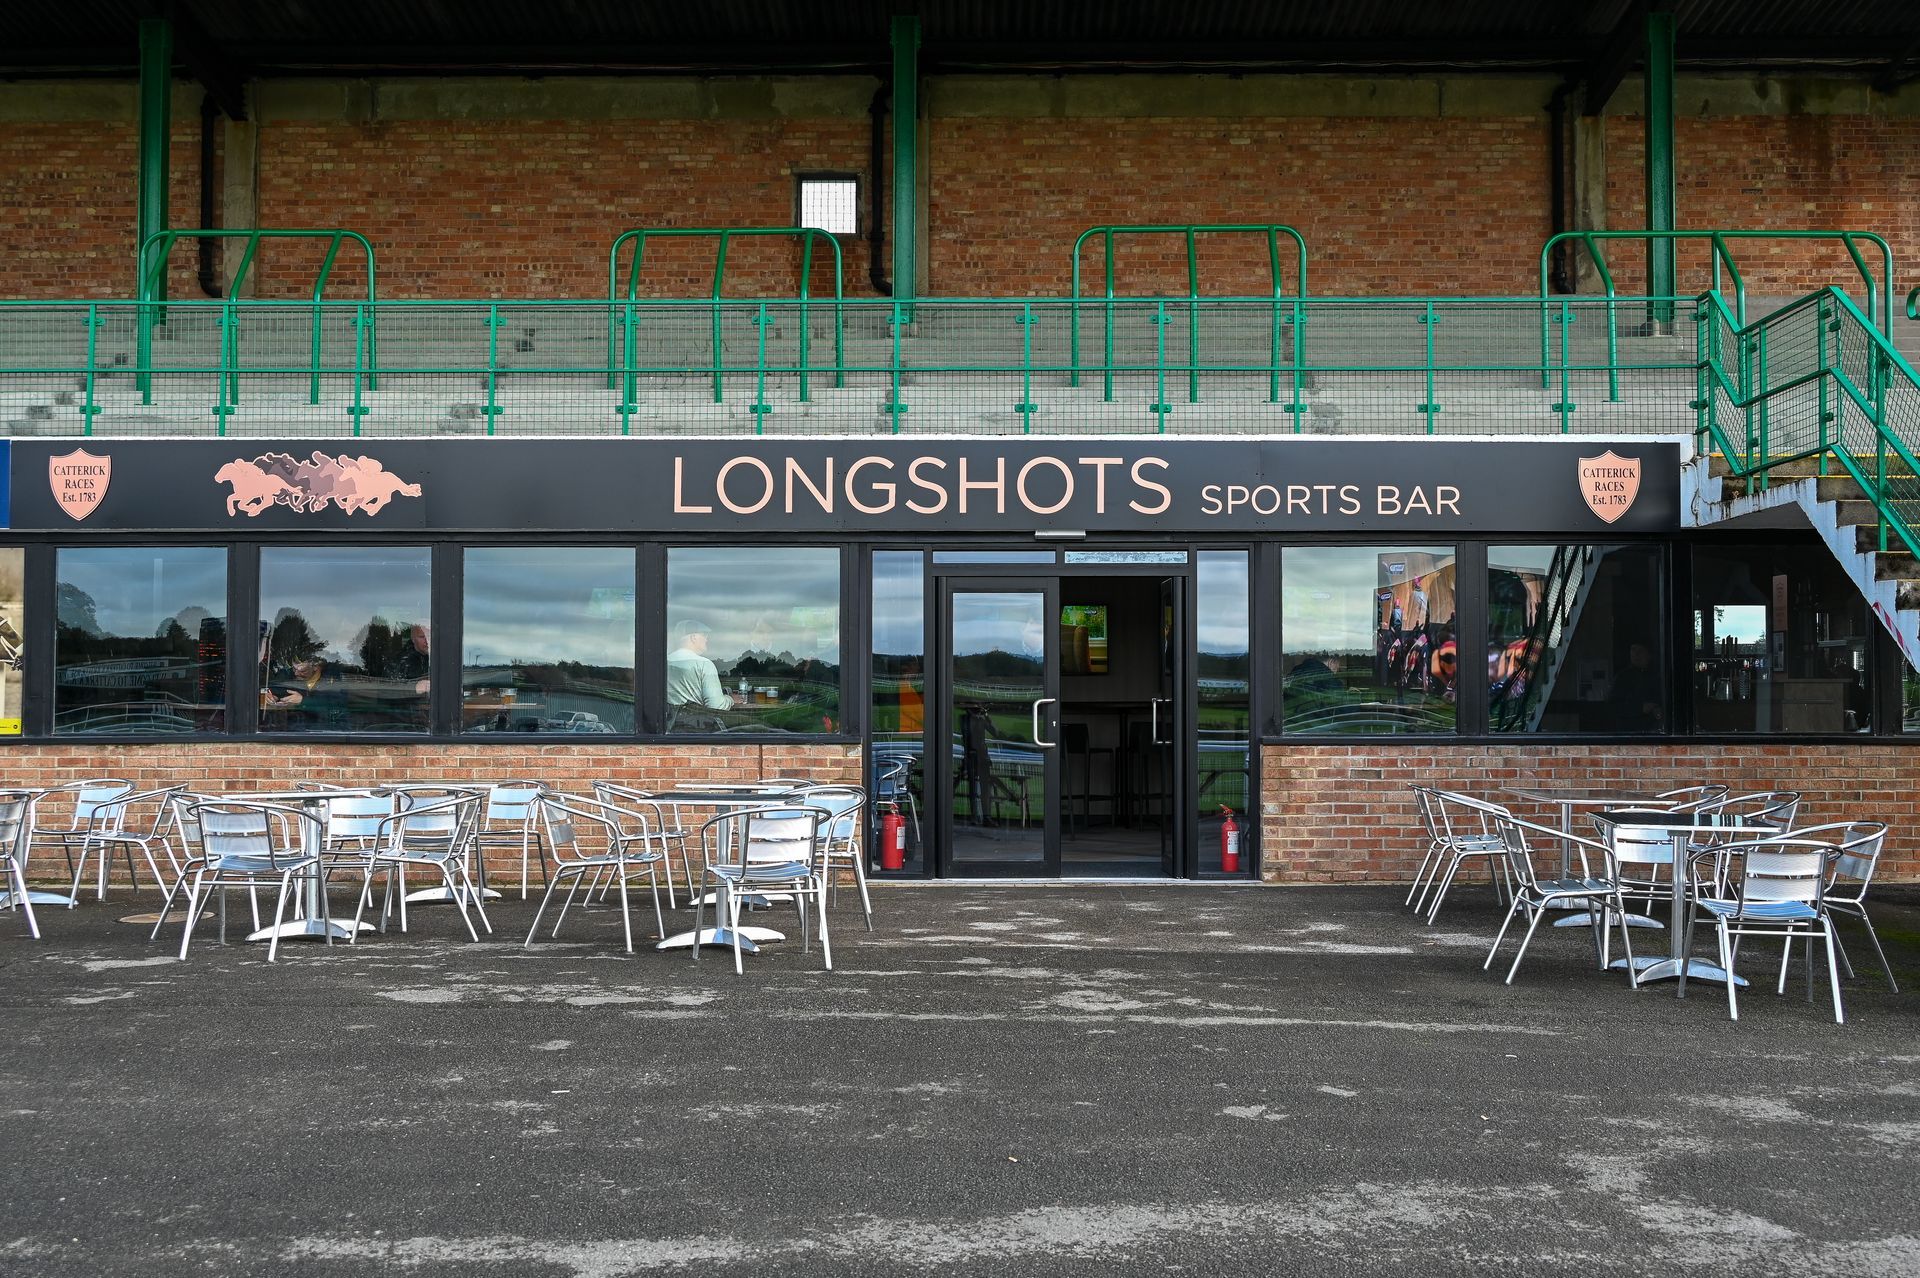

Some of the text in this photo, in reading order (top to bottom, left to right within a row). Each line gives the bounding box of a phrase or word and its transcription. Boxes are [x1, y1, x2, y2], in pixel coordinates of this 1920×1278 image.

[53, 465, 106, 477] CATTERICK
[1583, 468, 1636, 479] CATTERICK
[65, 479, 95, 490] RACES
[673, 455, 1462, 516] LONGSHOTS SPORTS BAR
[1594, 481, 1625, 492] RACES
[62, 492, 97, 504] Est. 1783
[1592, 495, 1627, 505] Est. 1783
